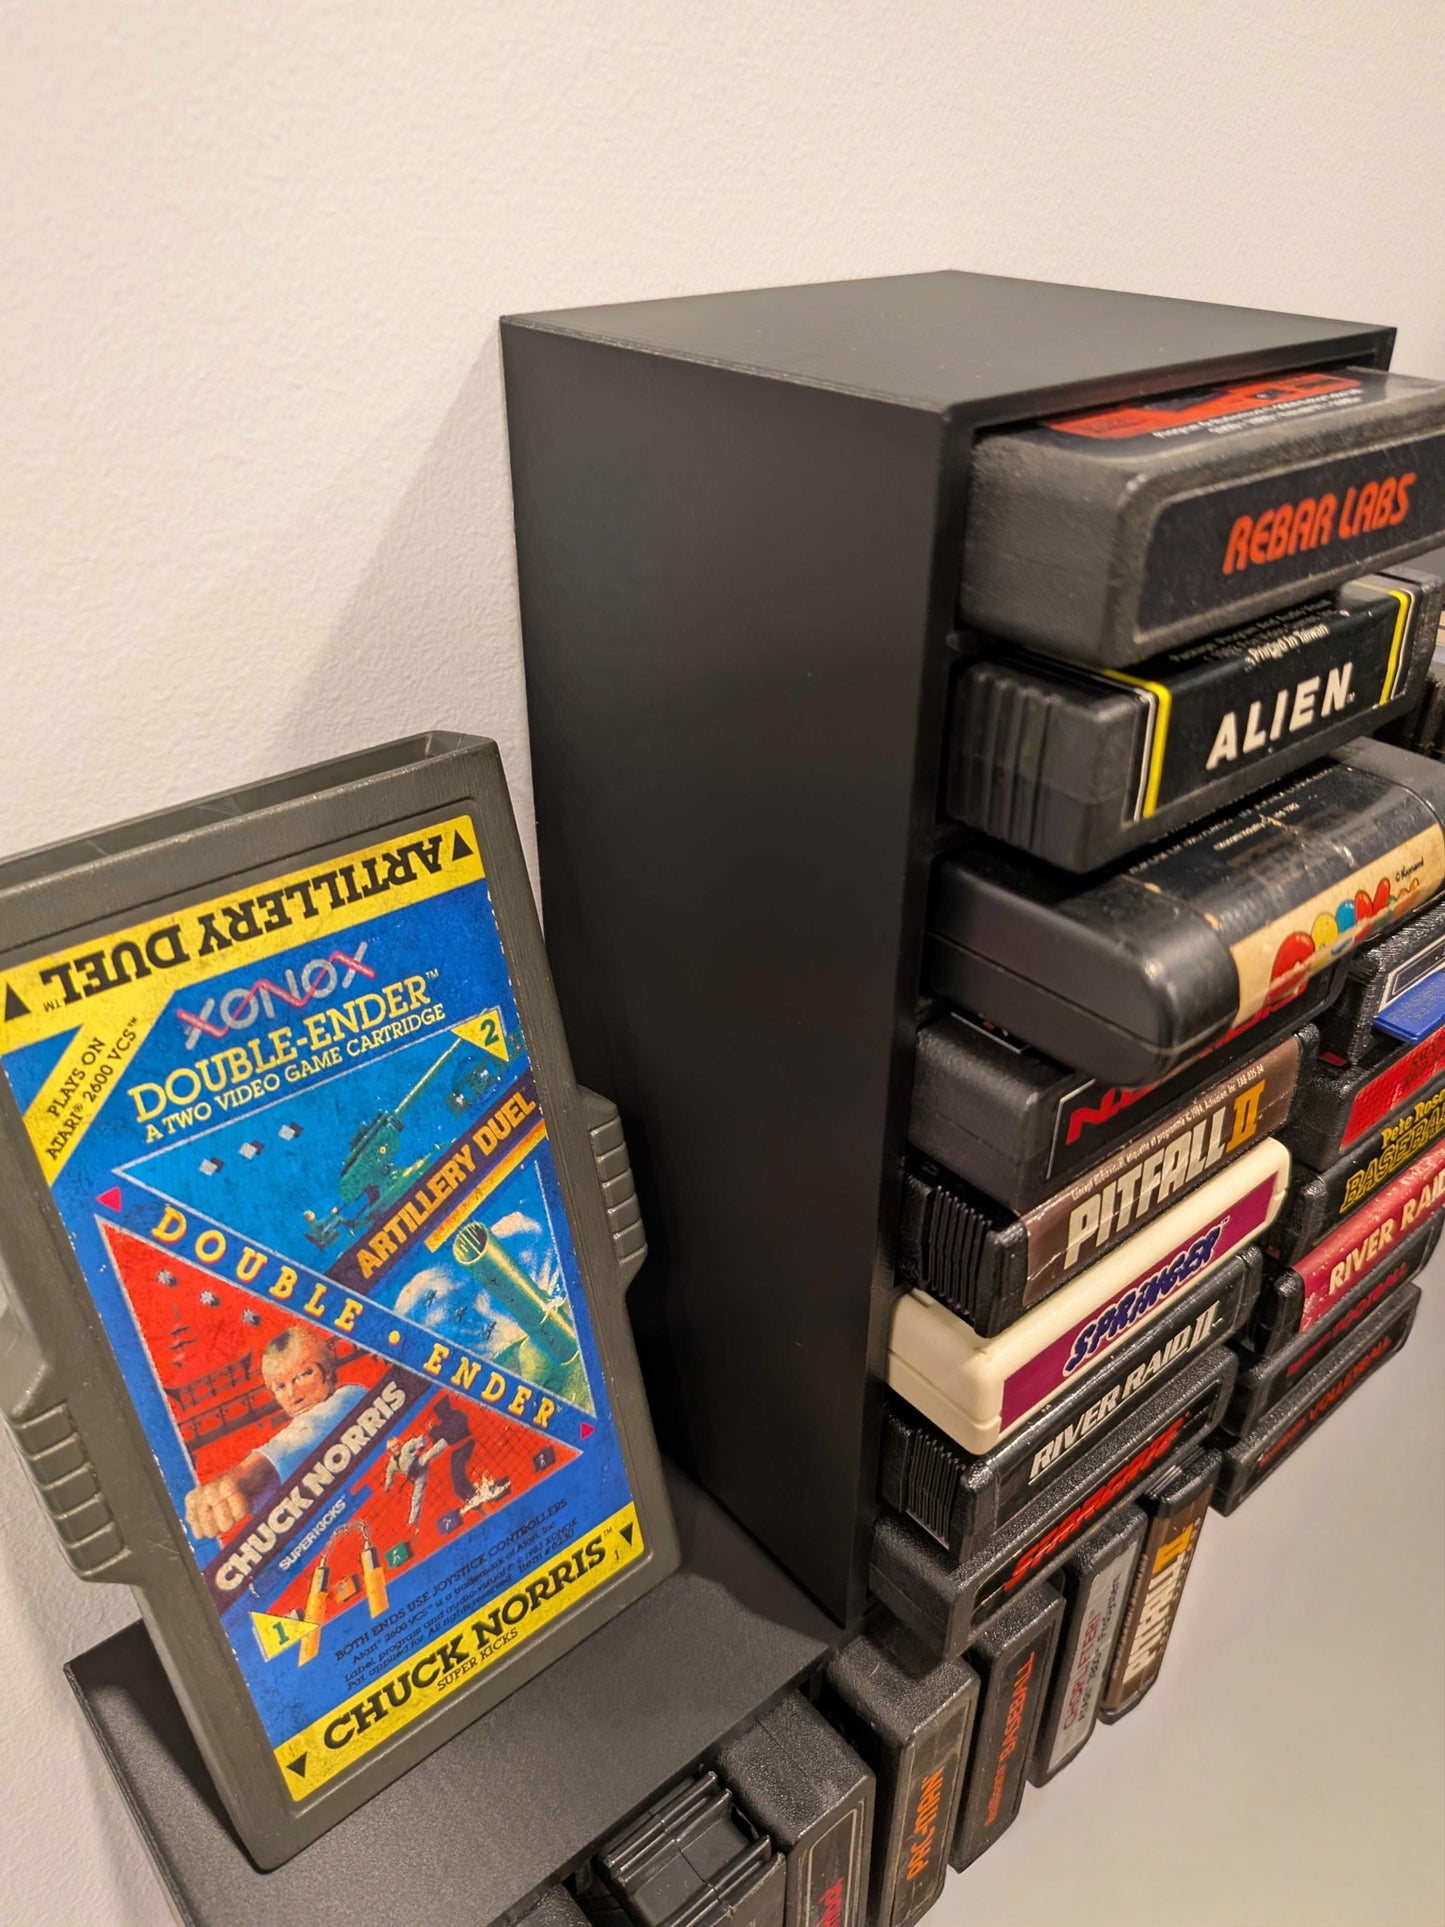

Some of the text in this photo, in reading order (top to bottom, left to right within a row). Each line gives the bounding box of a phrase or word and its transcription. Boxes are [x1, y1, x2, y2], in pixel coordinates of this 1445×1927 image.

[1223, 472, 1417, 574] REBAR LABS
[1205, 662, 1353, 770] ALIEN
[198, 835, 443, 957] ARTILLERY
[176, 941, 377, 1050] XONOX
[481, 1018, 499, 1047] 2
[47, 1037, 106, 1118] PLAYS ON
[82, 1064, 114, 1103] 2600
[145, 1003, 446, 1143] A TWO VIDEO GAME CARTRIDGE
[356, 1091, 537, 1280] ARTILLERY DUEL
[1064, 1106, 1226, 1270] PITFALL
[1226, 1080, 1266, 1153] II
[1382, 1115, 1413, 1149] Pete
[1329, 1218, 1395, 1295] RIVER
[151, 1204, 556, 1429] DOUBLE ENDER
[1029, 1384, 1120, 1480] RIVER
[1122, 1324, 1192, 1400] RAID
[215, 1380, 406, 1592] CHUCK NORRIS
[334, 1497, 568, 1662] BOTH ENDS USE JOYSTICK CONTROLLERS
[454, 1558, 503, 1594] trademark
[1122, 1552, 1186, 1684] PITFALL
[272, 1622, 290, 1647] 1
[437, 1626, 519, 1692] SUPER KICKS
[323, 1634, 470, 1750] CHUCK
[999, 1651, 1035, 1762] BASEBALL
[906, 1766, 945, 1880] PAC-MAN
